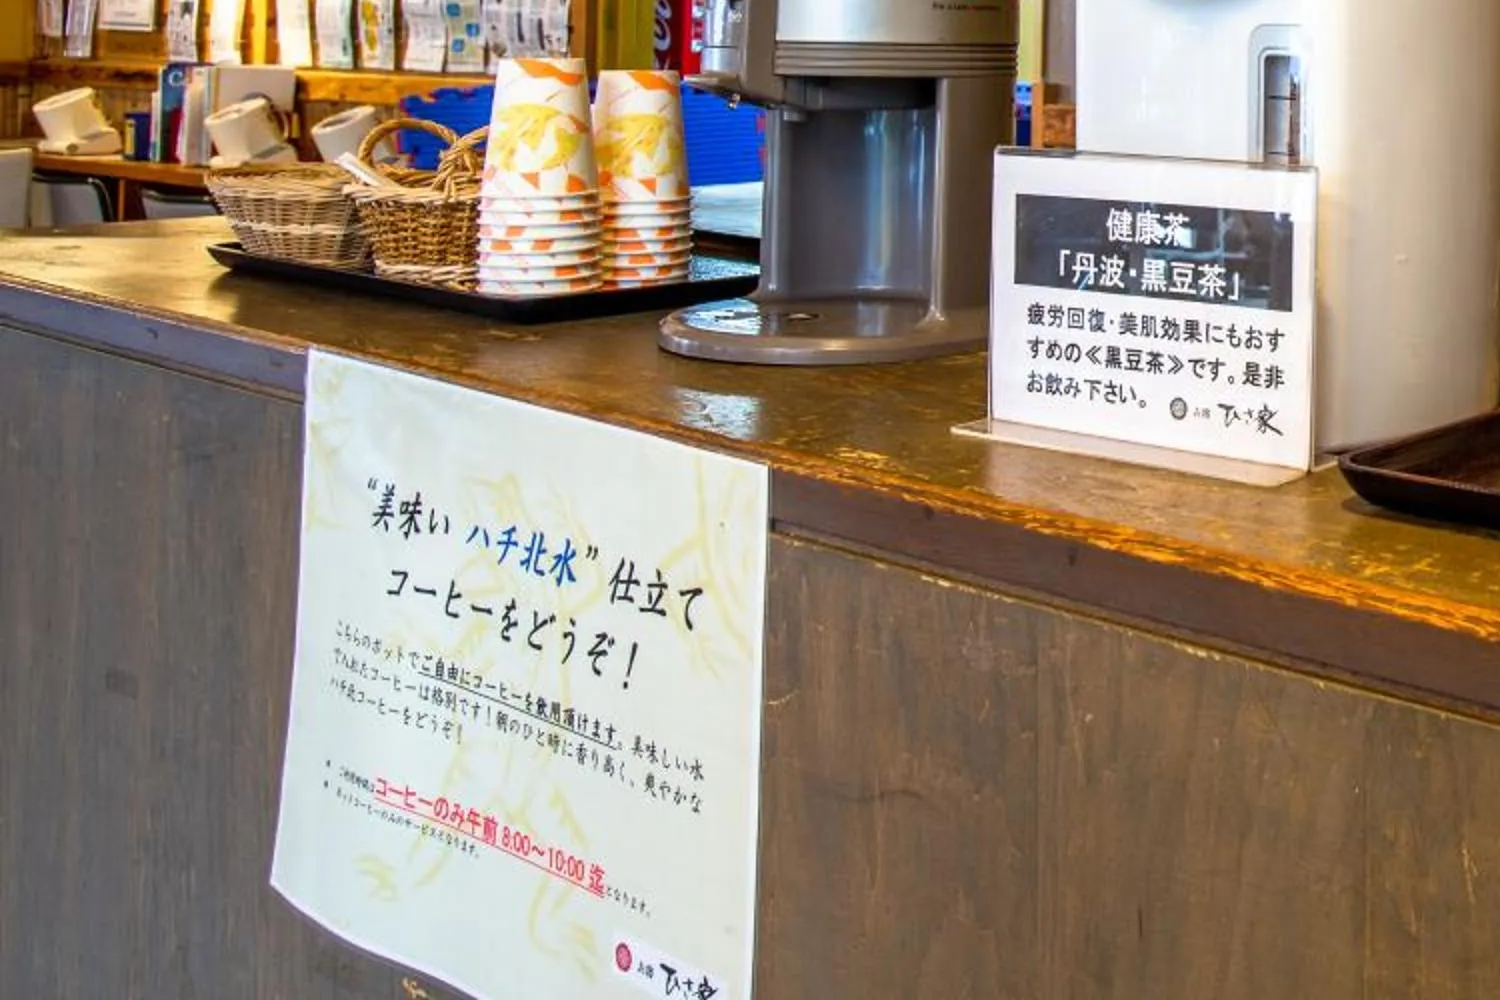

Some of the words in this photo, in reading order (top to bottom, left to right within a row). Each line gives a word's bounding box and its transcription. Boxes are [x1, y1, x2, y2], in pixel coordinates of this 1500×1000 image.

[1106, 207, 1190, 248] 健康茶
[1057, 249, 1240, 301] 「丹波・黒豆茶」
[1027, 301, 1286, 353] 疲労回復・美肌効果にもおす
[1026, 372, 1147, 409] お飲み下さい。
[608, 560, 705, 631] 仕立て
